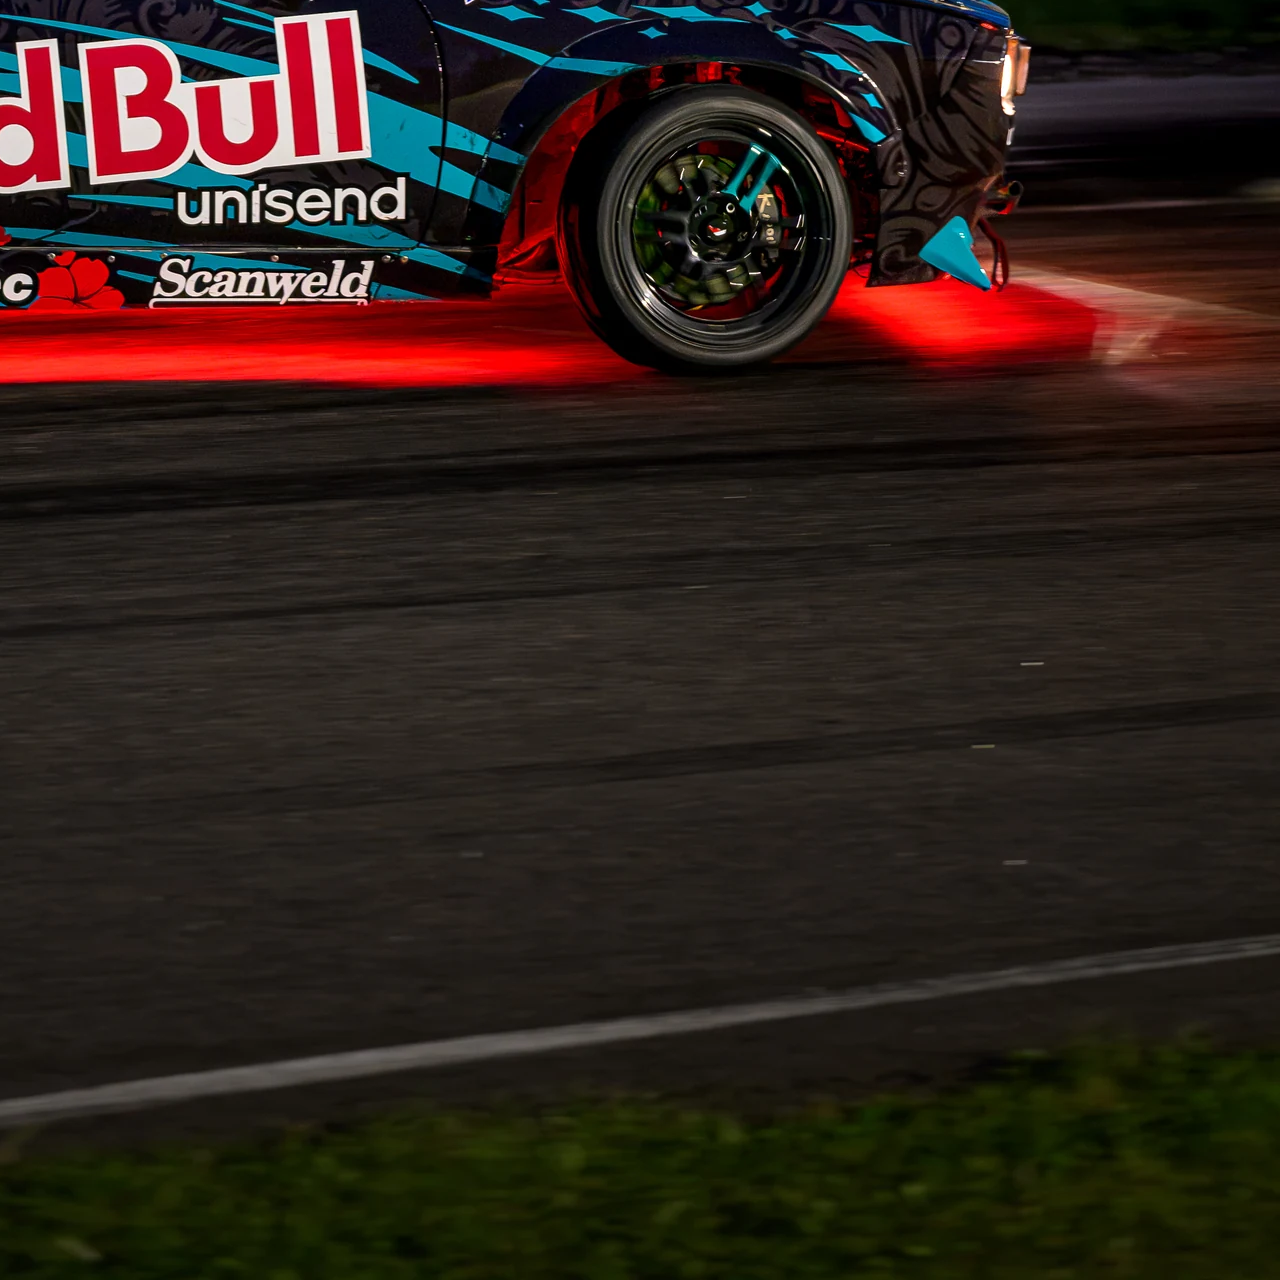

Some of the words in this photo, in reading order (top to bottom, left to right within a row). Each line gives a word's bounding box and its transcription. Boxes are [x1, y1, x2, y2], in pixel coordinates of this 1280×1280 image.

[86, 17, 365, 179] Bull
[177, 177, 407, 226] unisend
[152, 258, 375, 306] Scanweld
